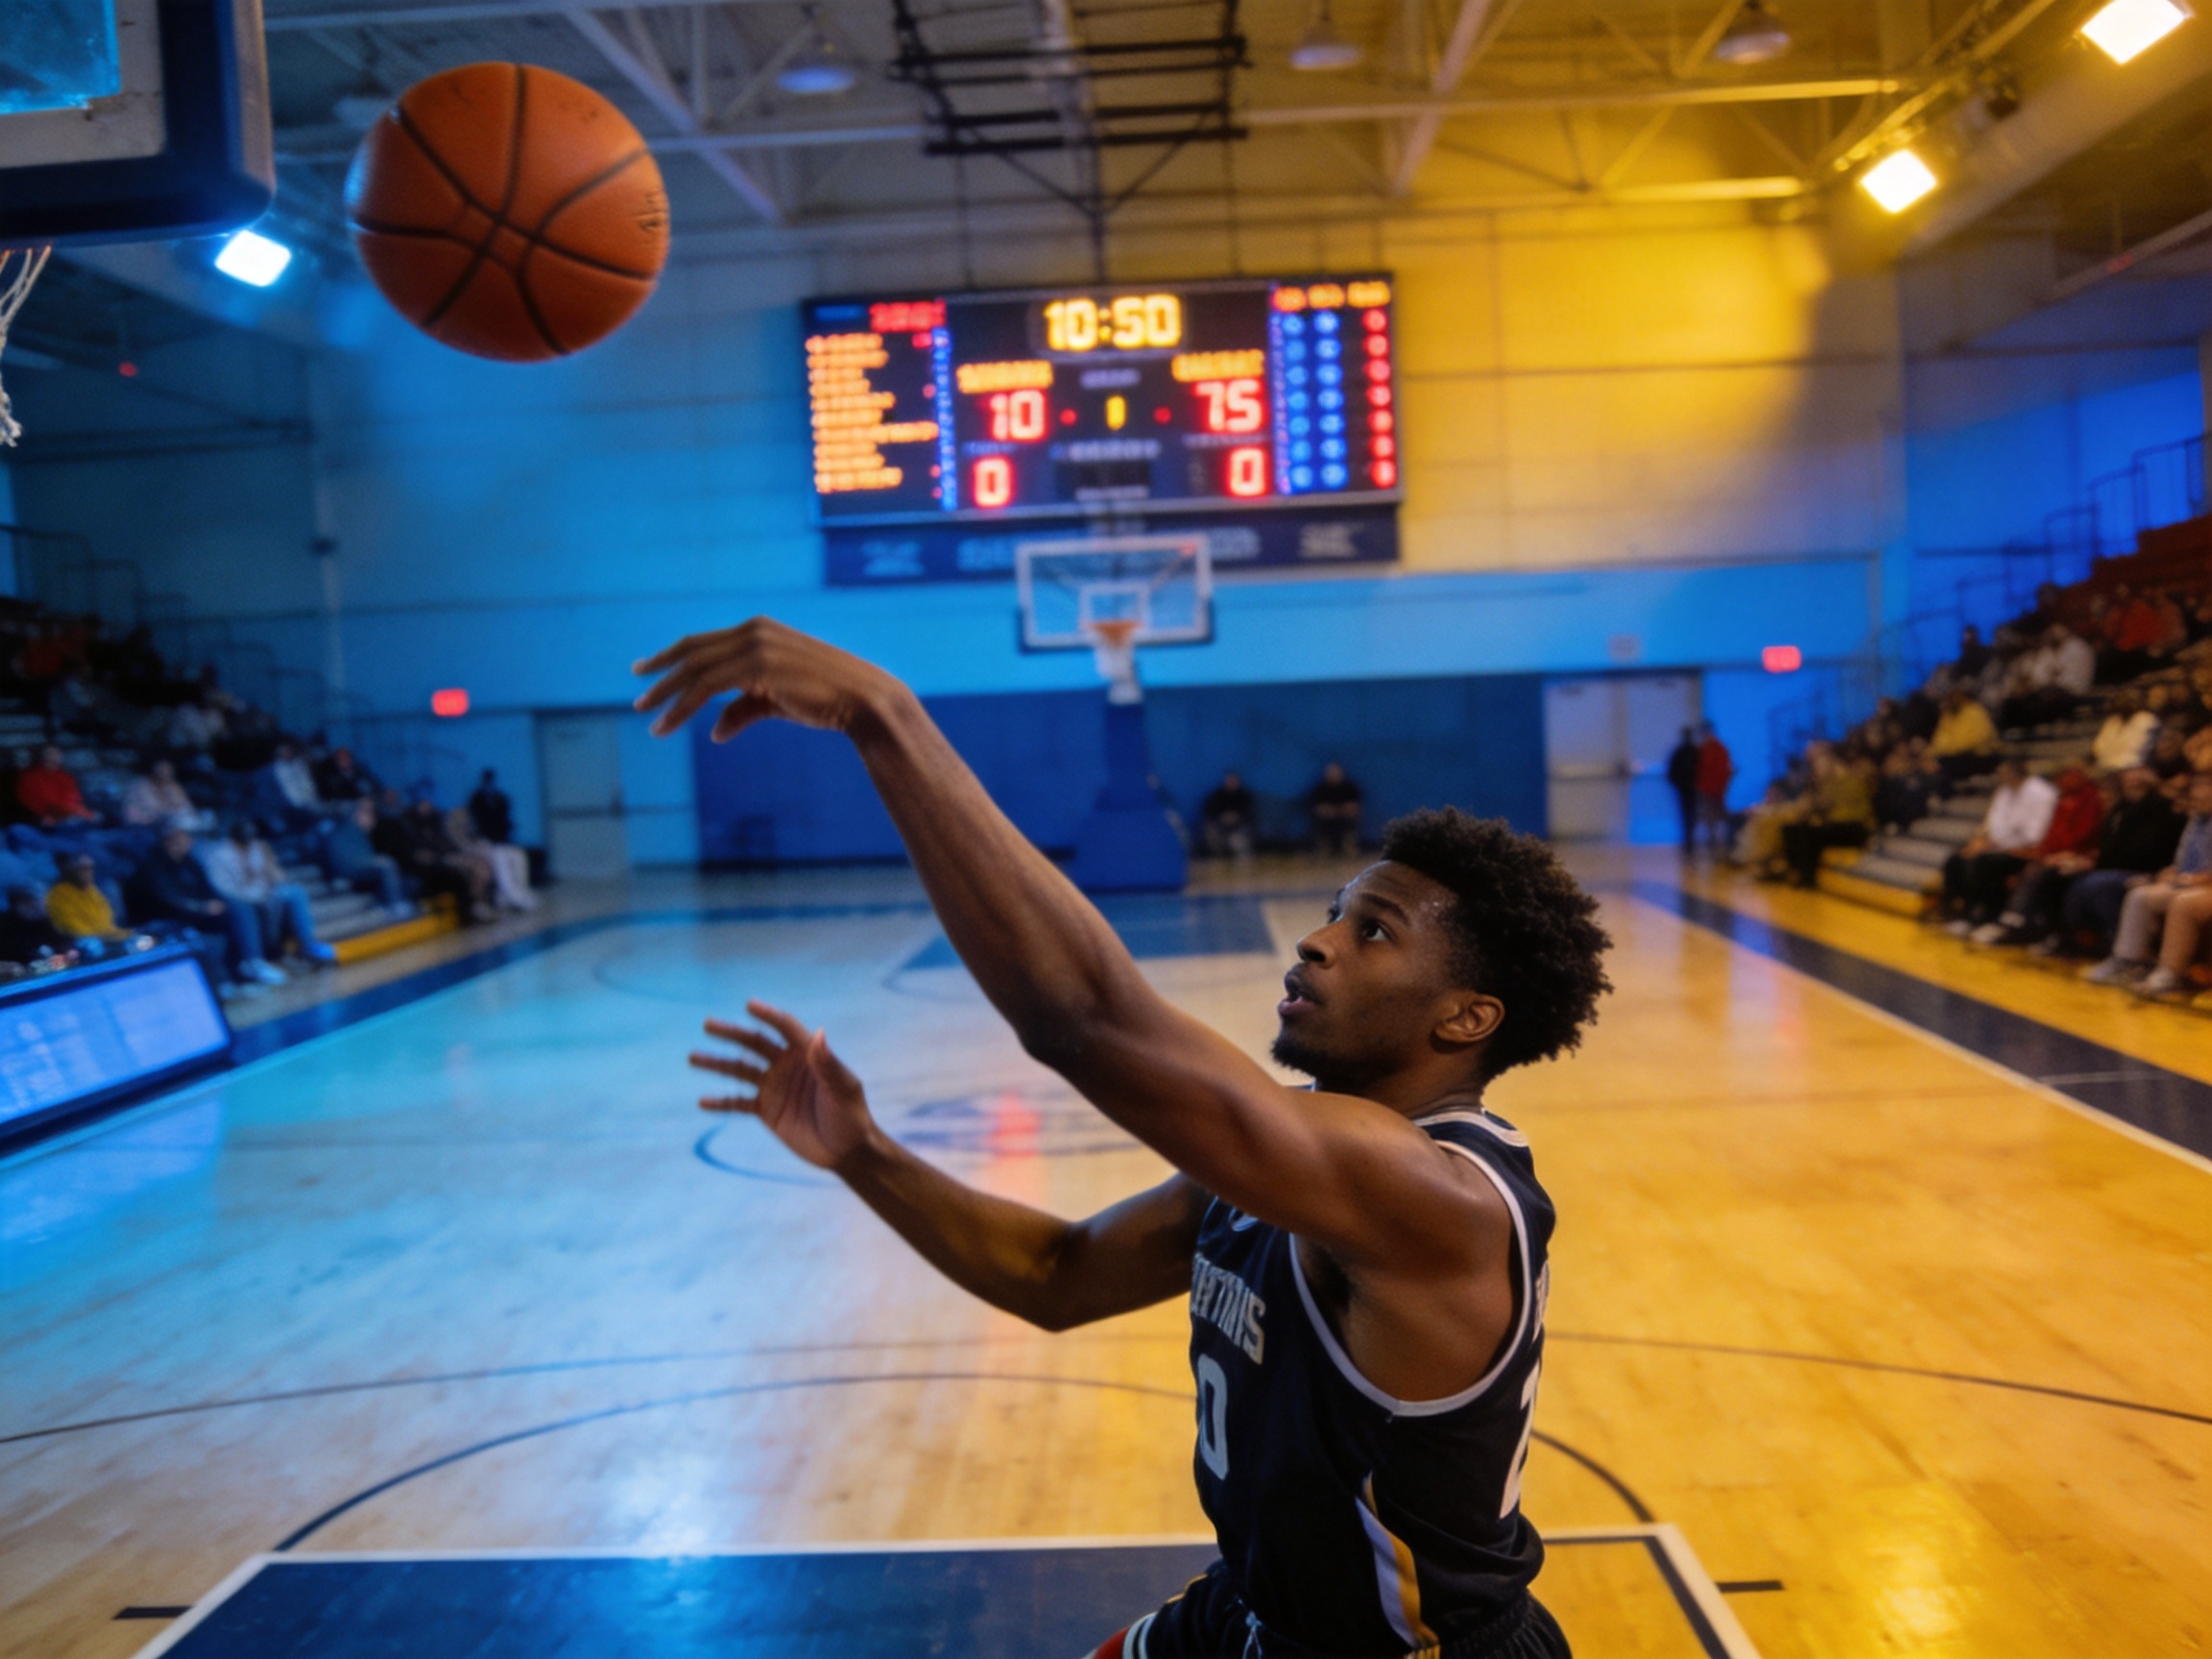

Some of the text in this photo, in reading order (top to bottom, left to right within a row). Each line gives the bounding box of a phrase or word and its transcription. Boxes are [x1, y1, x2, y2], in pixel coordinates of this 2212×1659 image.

[1045, 295, 1181, 350] 10:50
[990, 389, 1045, 441] 10
[1194, 378, 1262, 432] 75
[974, 457, 1011, 506] 0
[1229, 446, 1265, 496] 0
